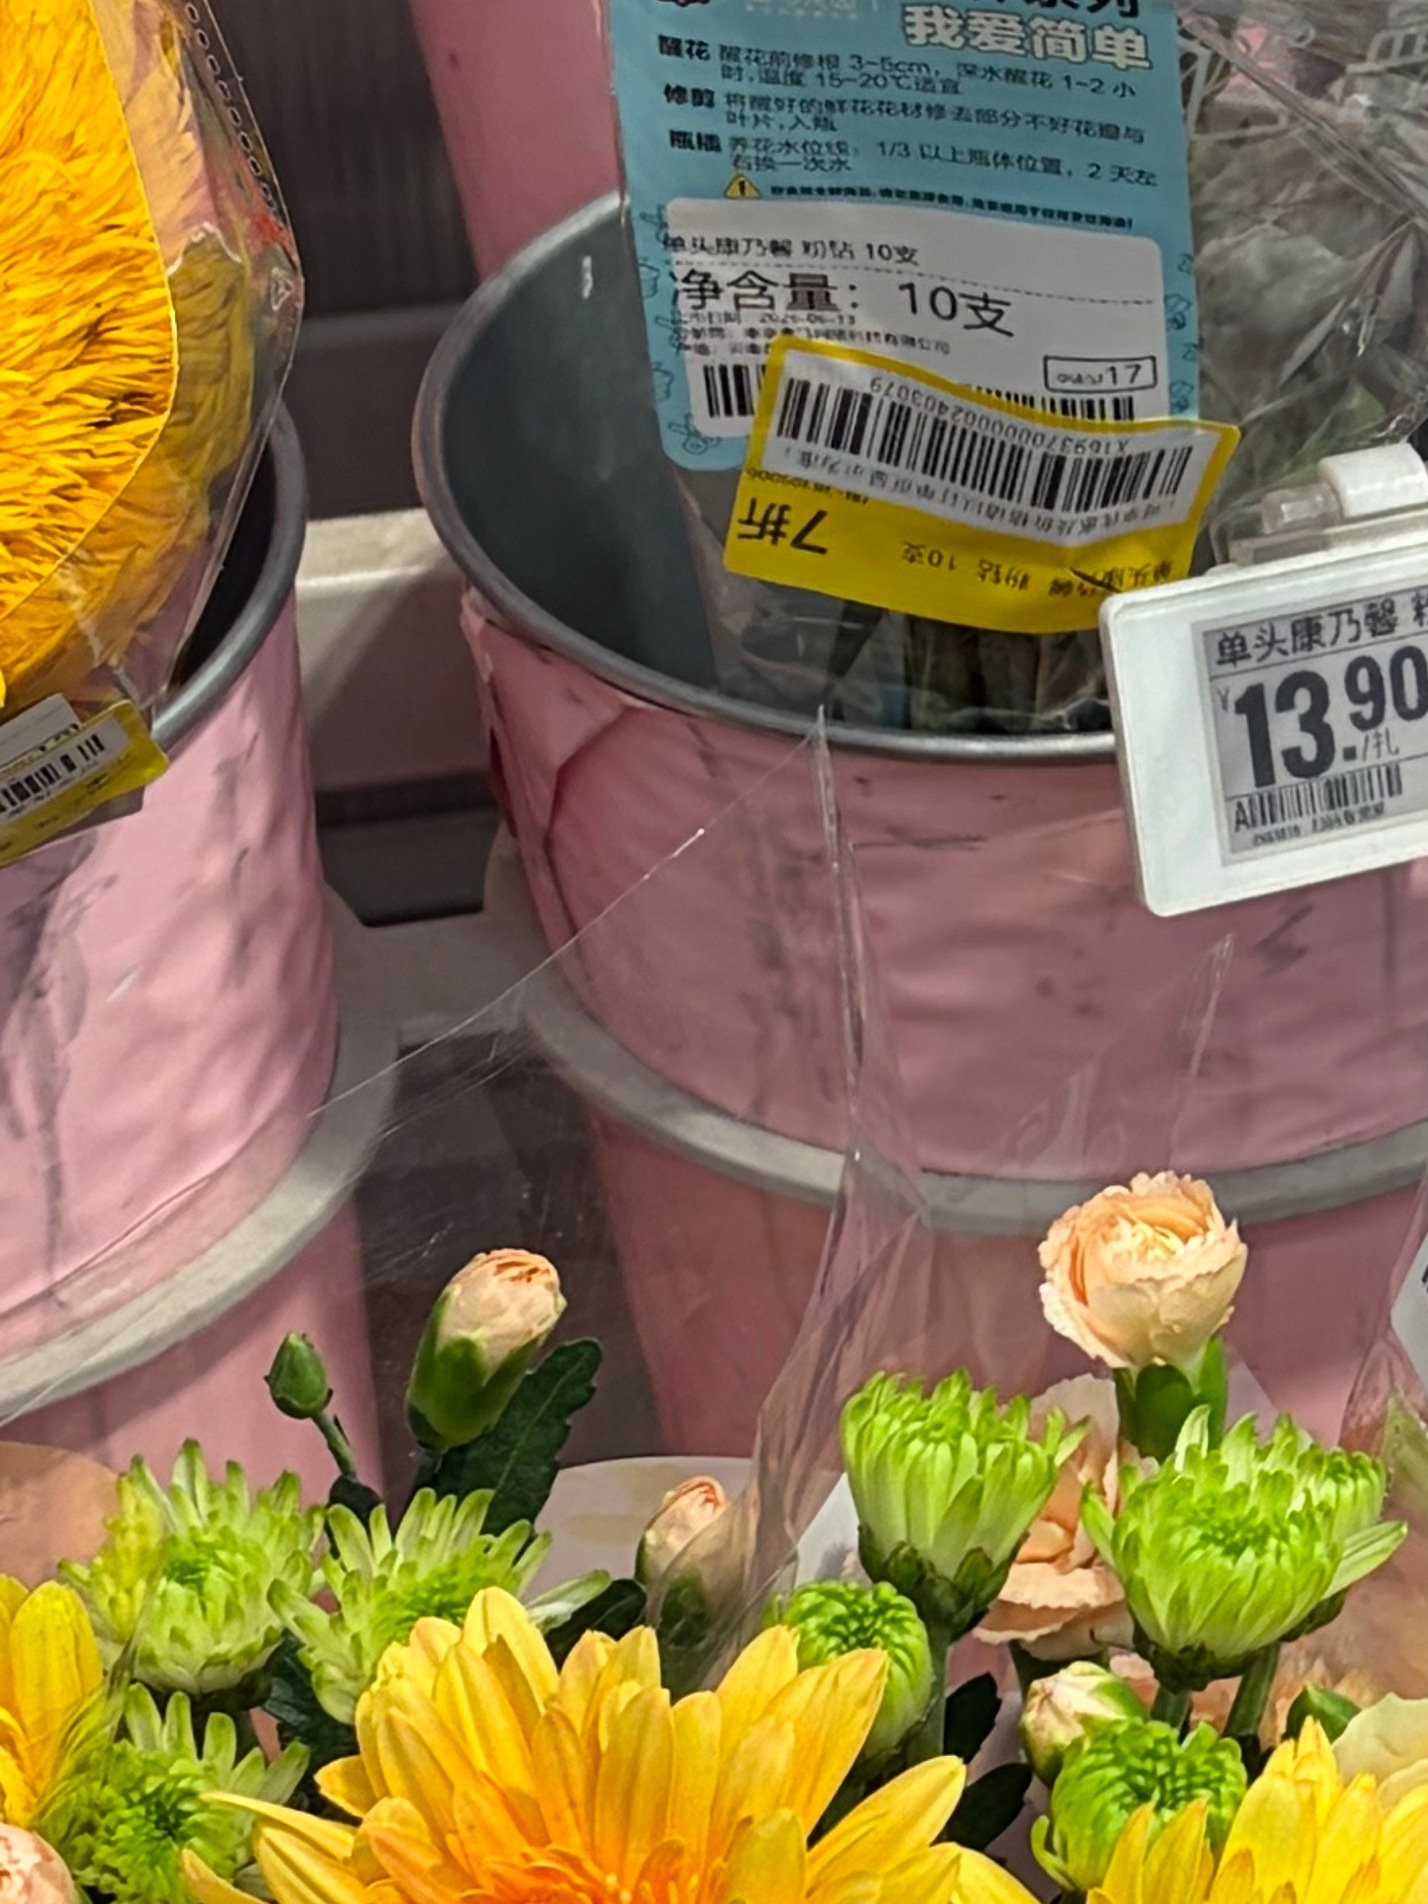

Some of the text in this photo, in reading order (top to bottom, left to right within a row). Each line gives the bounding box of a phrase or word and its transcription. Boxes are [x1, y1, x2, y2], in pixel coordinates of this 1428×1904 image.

[901, 4, 1153, 70] 我爱简单
[876, 141, 911, 159] 1/3
[1088, 162, 1103, 180] 2
[865, 242, 920, 268] 10支
[898, 282, 1015, 338] 10支
[735, 497, 830, 558] 7折
[901, 539, 959, 573] 10支
[1215, 596, 1399, 667] 单头康乃馨
